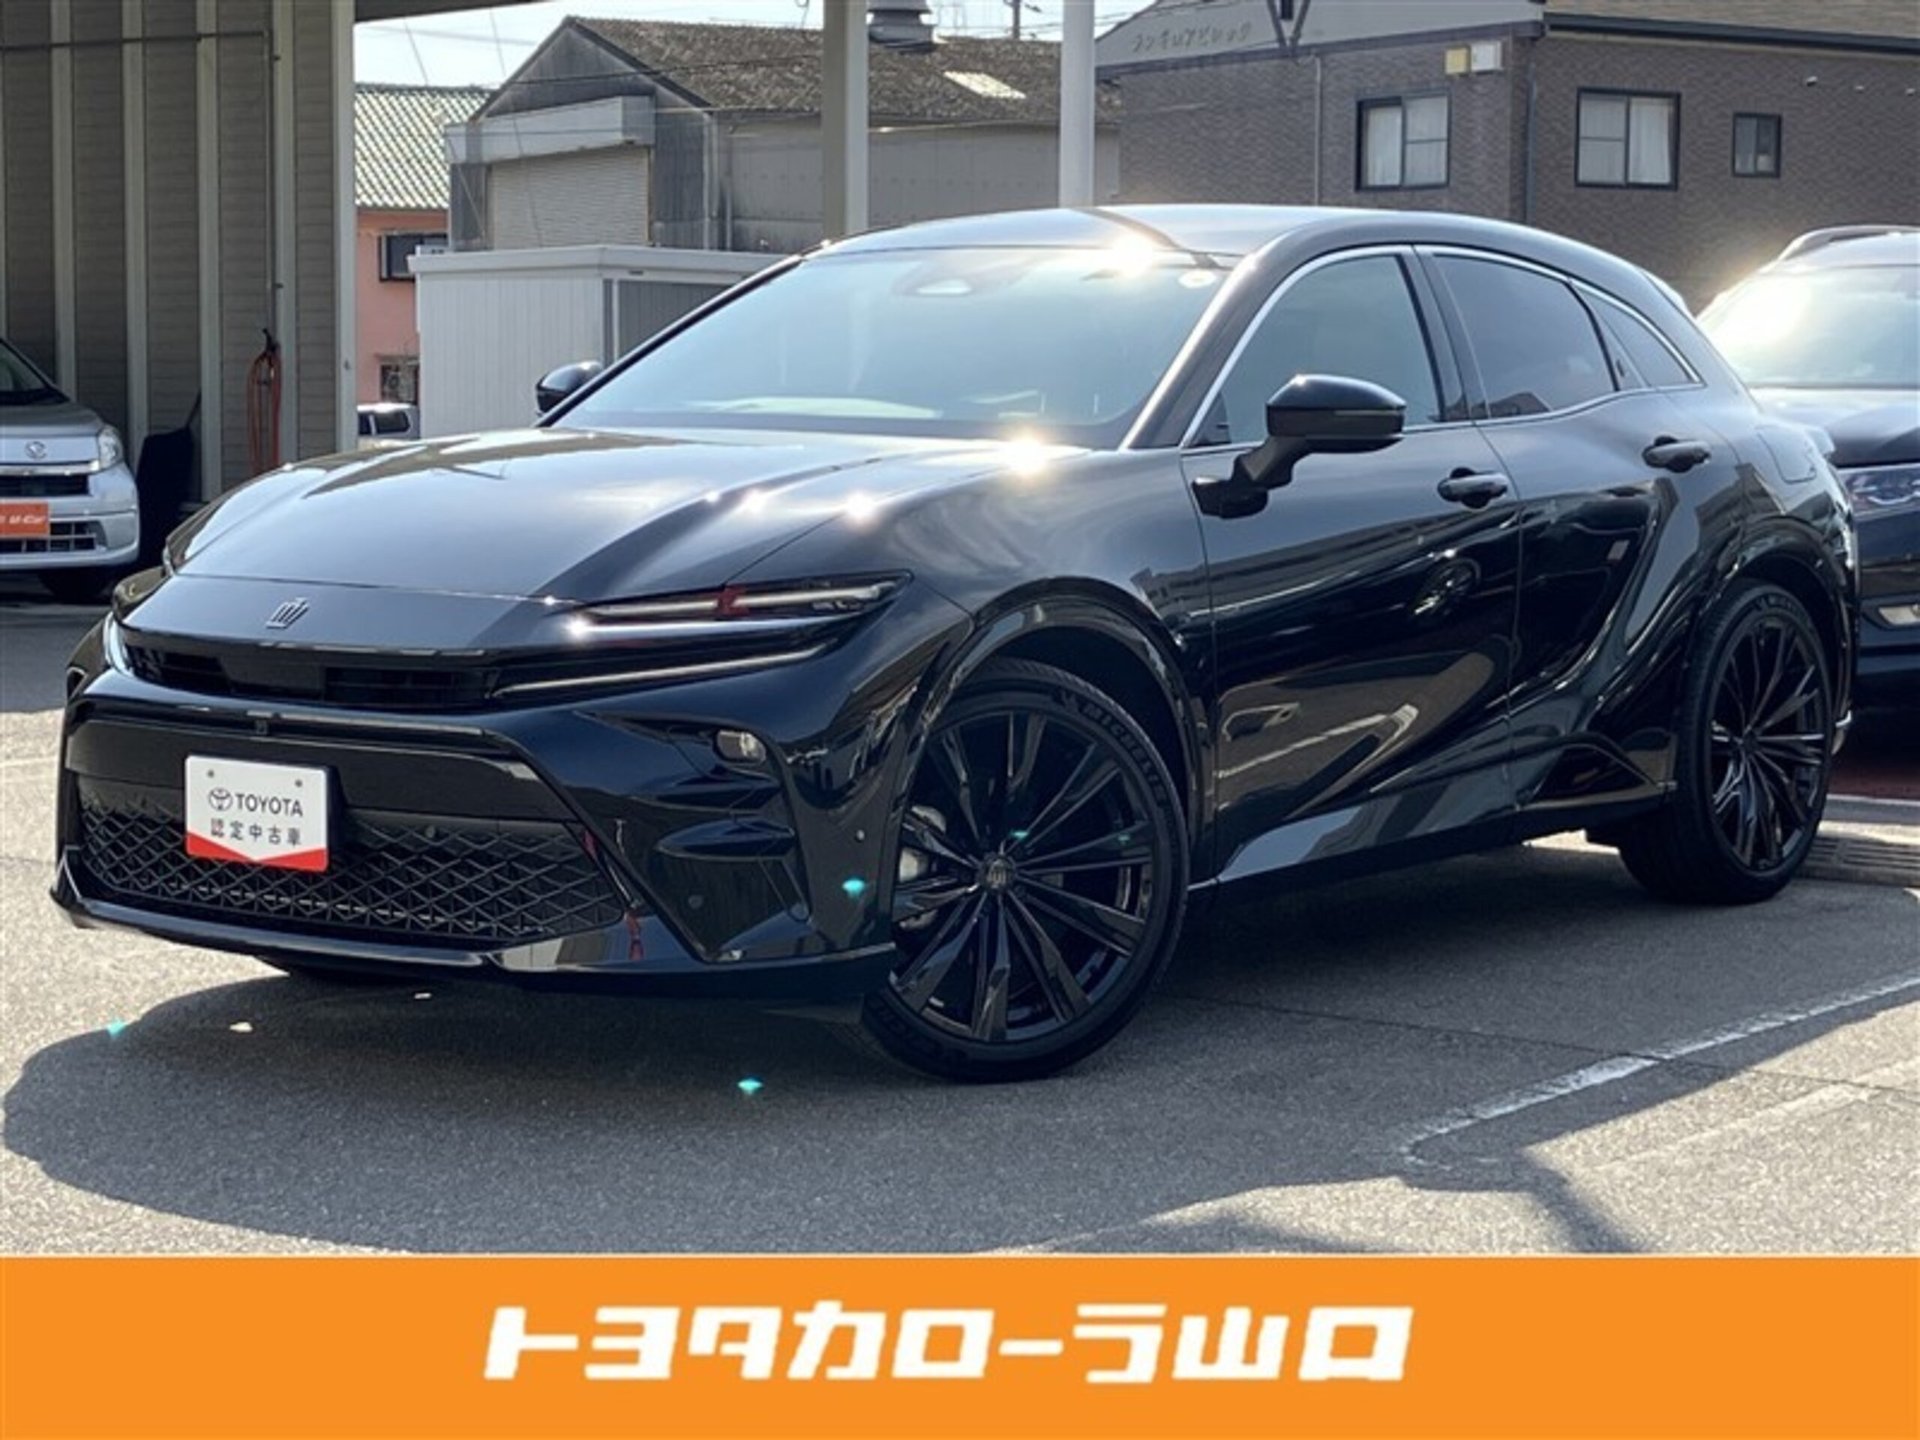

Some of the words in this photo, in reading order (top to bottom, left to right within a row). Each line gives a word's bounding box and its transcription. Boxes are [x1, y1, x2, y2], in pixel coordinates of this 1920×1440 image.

[235, 793, 303, 817] TOYOTA
[210, 817, 301, 847] 認定中古車
